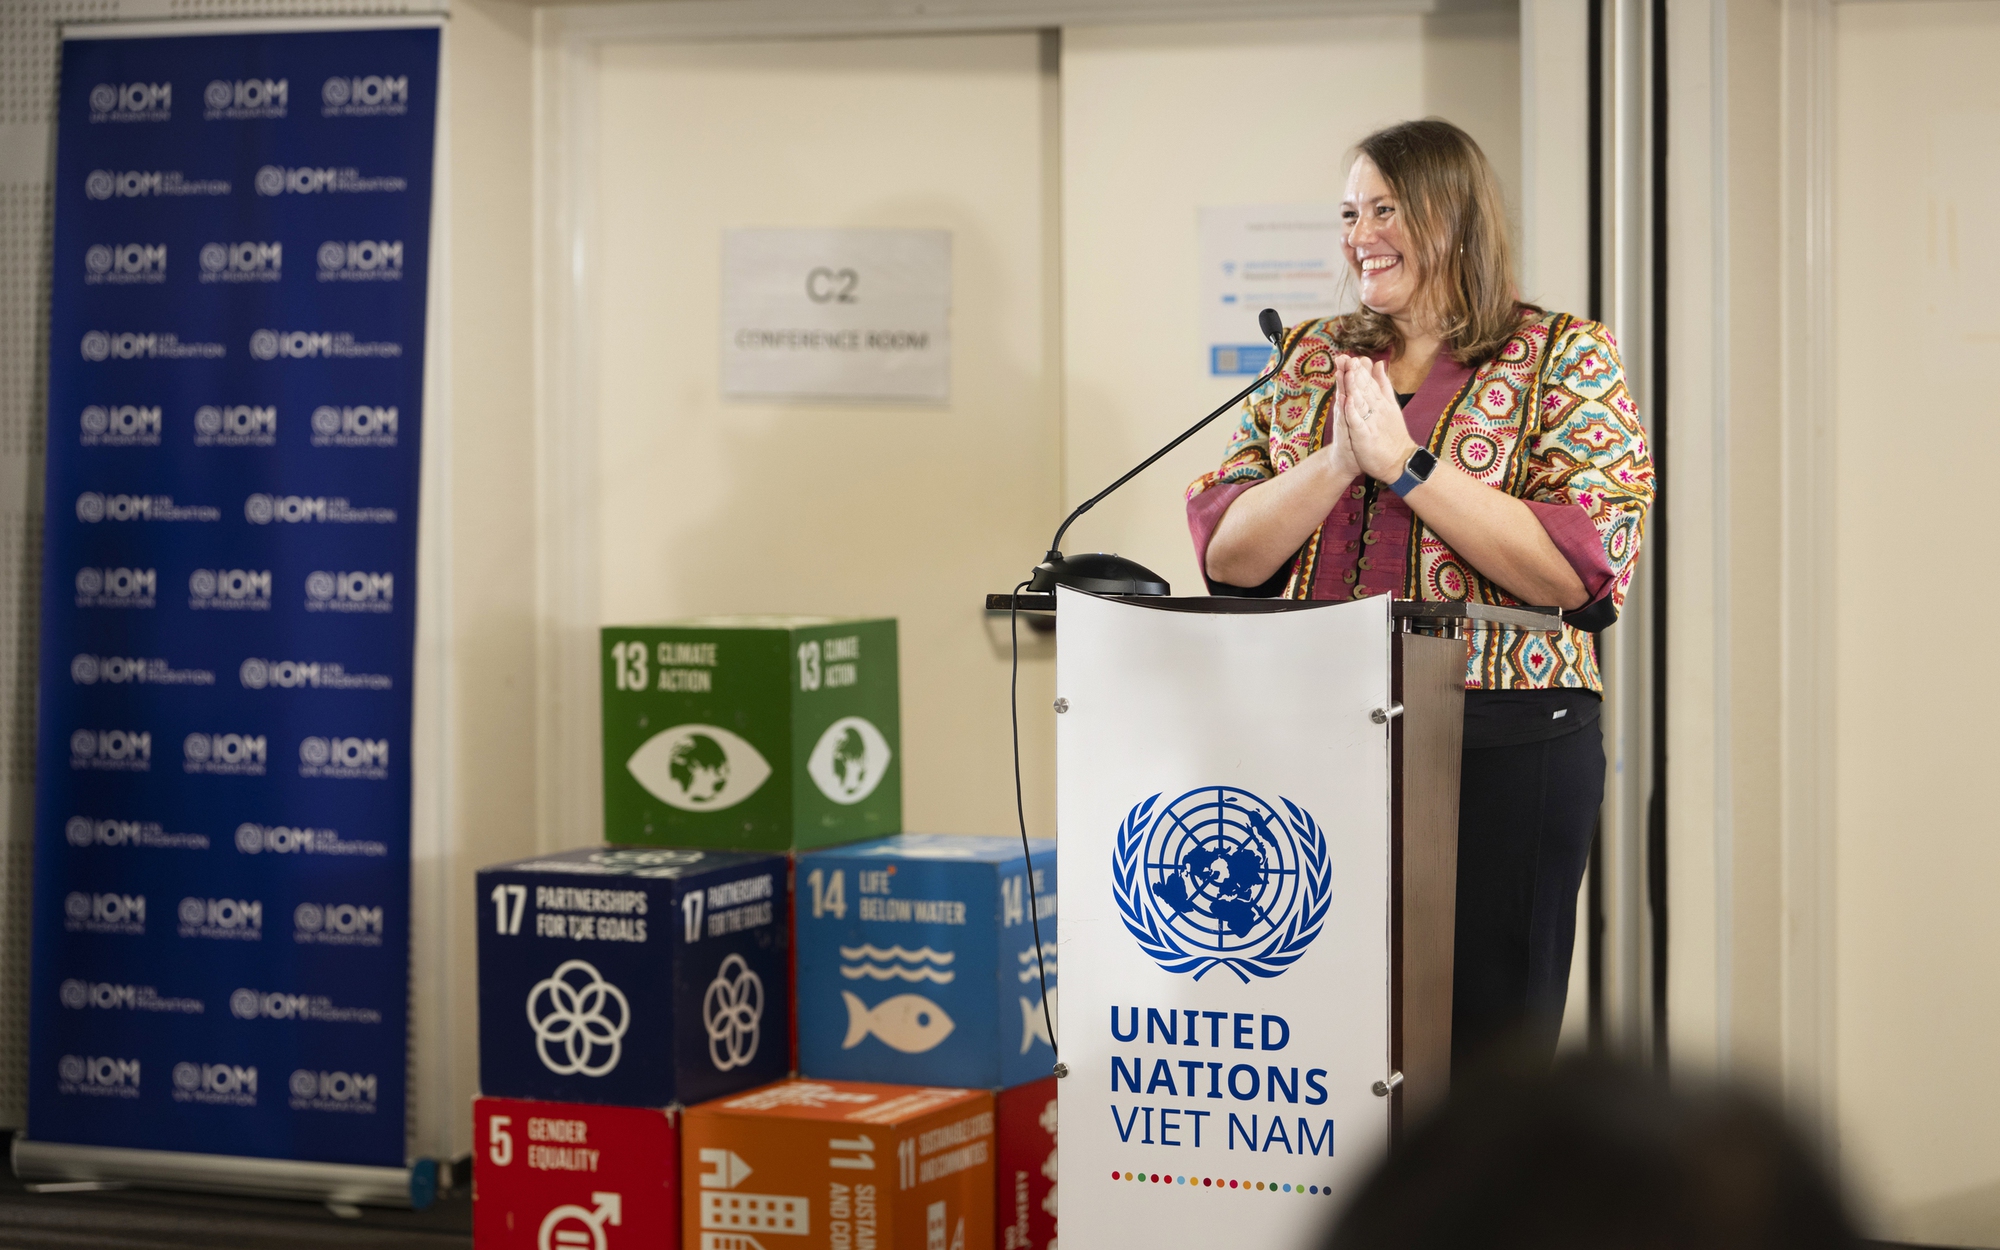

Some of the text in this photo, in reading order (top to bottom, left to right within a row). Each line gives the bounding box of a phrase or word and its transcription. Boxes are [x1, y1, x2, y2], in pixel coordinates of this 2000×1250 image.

[118, 81, 172, 111] IOM
[234, 78, 288, 108] IOM
[352, 75, 407, 106] IOM
[111, 170, 161, 197] IOM
[286, 167, 335, 194] IOM
[114, 243, 166, 273] IOM
[229, 241, 282, 271] IOM
[347, 239, 403, 270] IOM
[805, 266, 859, 305] C2
[111, 332, 155, 359] IOM
[280, 330, 330, 358] IOM
[734, 327, 931, 353] CONFERENCE ROOM
[109, 405, 161, 435] IOM
[223, 405, 277, 435] IOM
[342, 405, 398, 435] IOM
[105, 493, 150, 521] IOM
[273, 496, 324, 523] IOM
[105, 567, 156, 597] IOM
[217, 568, 271, 599] IOM
[337, 571, 393, 601] IOM
[611, 640, 649, 691] 13
[657, 641, 718, 667] CLIMATE
[796, 640, 821, 691] 13
[100, 656, 145, 684] IOM
[269, 660, 320, 688] IOM
[657, 669, 712, 692] ACTION
[100, 730, 151, 760] IOM
[212, 733, 267, 764] IOM
[331, 737, 388, 768] IOM
[94, 818, 140, 846] IOM
[264, 825, 313, 853] IOM
[807, 867, 847, 920] 14
[859, 870, 892, 895] LIFE
[93, 892, 146, 922] IOM
[206, 898, 262, 929] IOM
[491, 884, 527, 936] 17
[536, 885, 648, 916] PARTNERSHIPS
[859, 897, 967, 926] BELOW WATER
[1001, 875, 1023, 928] 14
[326, 903, 383, 934] IOM
[536, 913, 567, 938] FOR
[596, 916, 648, 943] GOALS
[682, 889, 704, 944] 17
[88, 982, 135, 1009] IOM
[259, 992, 309, 1019] IOM
[1110, 1005, 1290, 1051] UNITED
[87, 1056, 140, 1085] IOM
[201, 1063, 257, 1094] IOM
[320, 1071, 377, 1100] IOM
[1111, 1056, 1328, 1105] NATIONS
[489, 1115, 513, 1167] 5
[527, 1117, 588, 1144] GENDER
[1110, 1104, 1334, 1157] VIET NAM
[527, 1144, 600, 1173] EQUALITY
[828, 1134, 876, 1170] 11
[897, 1137, 915, 1191] 11
[829, 1181, 851, 1218] AND
